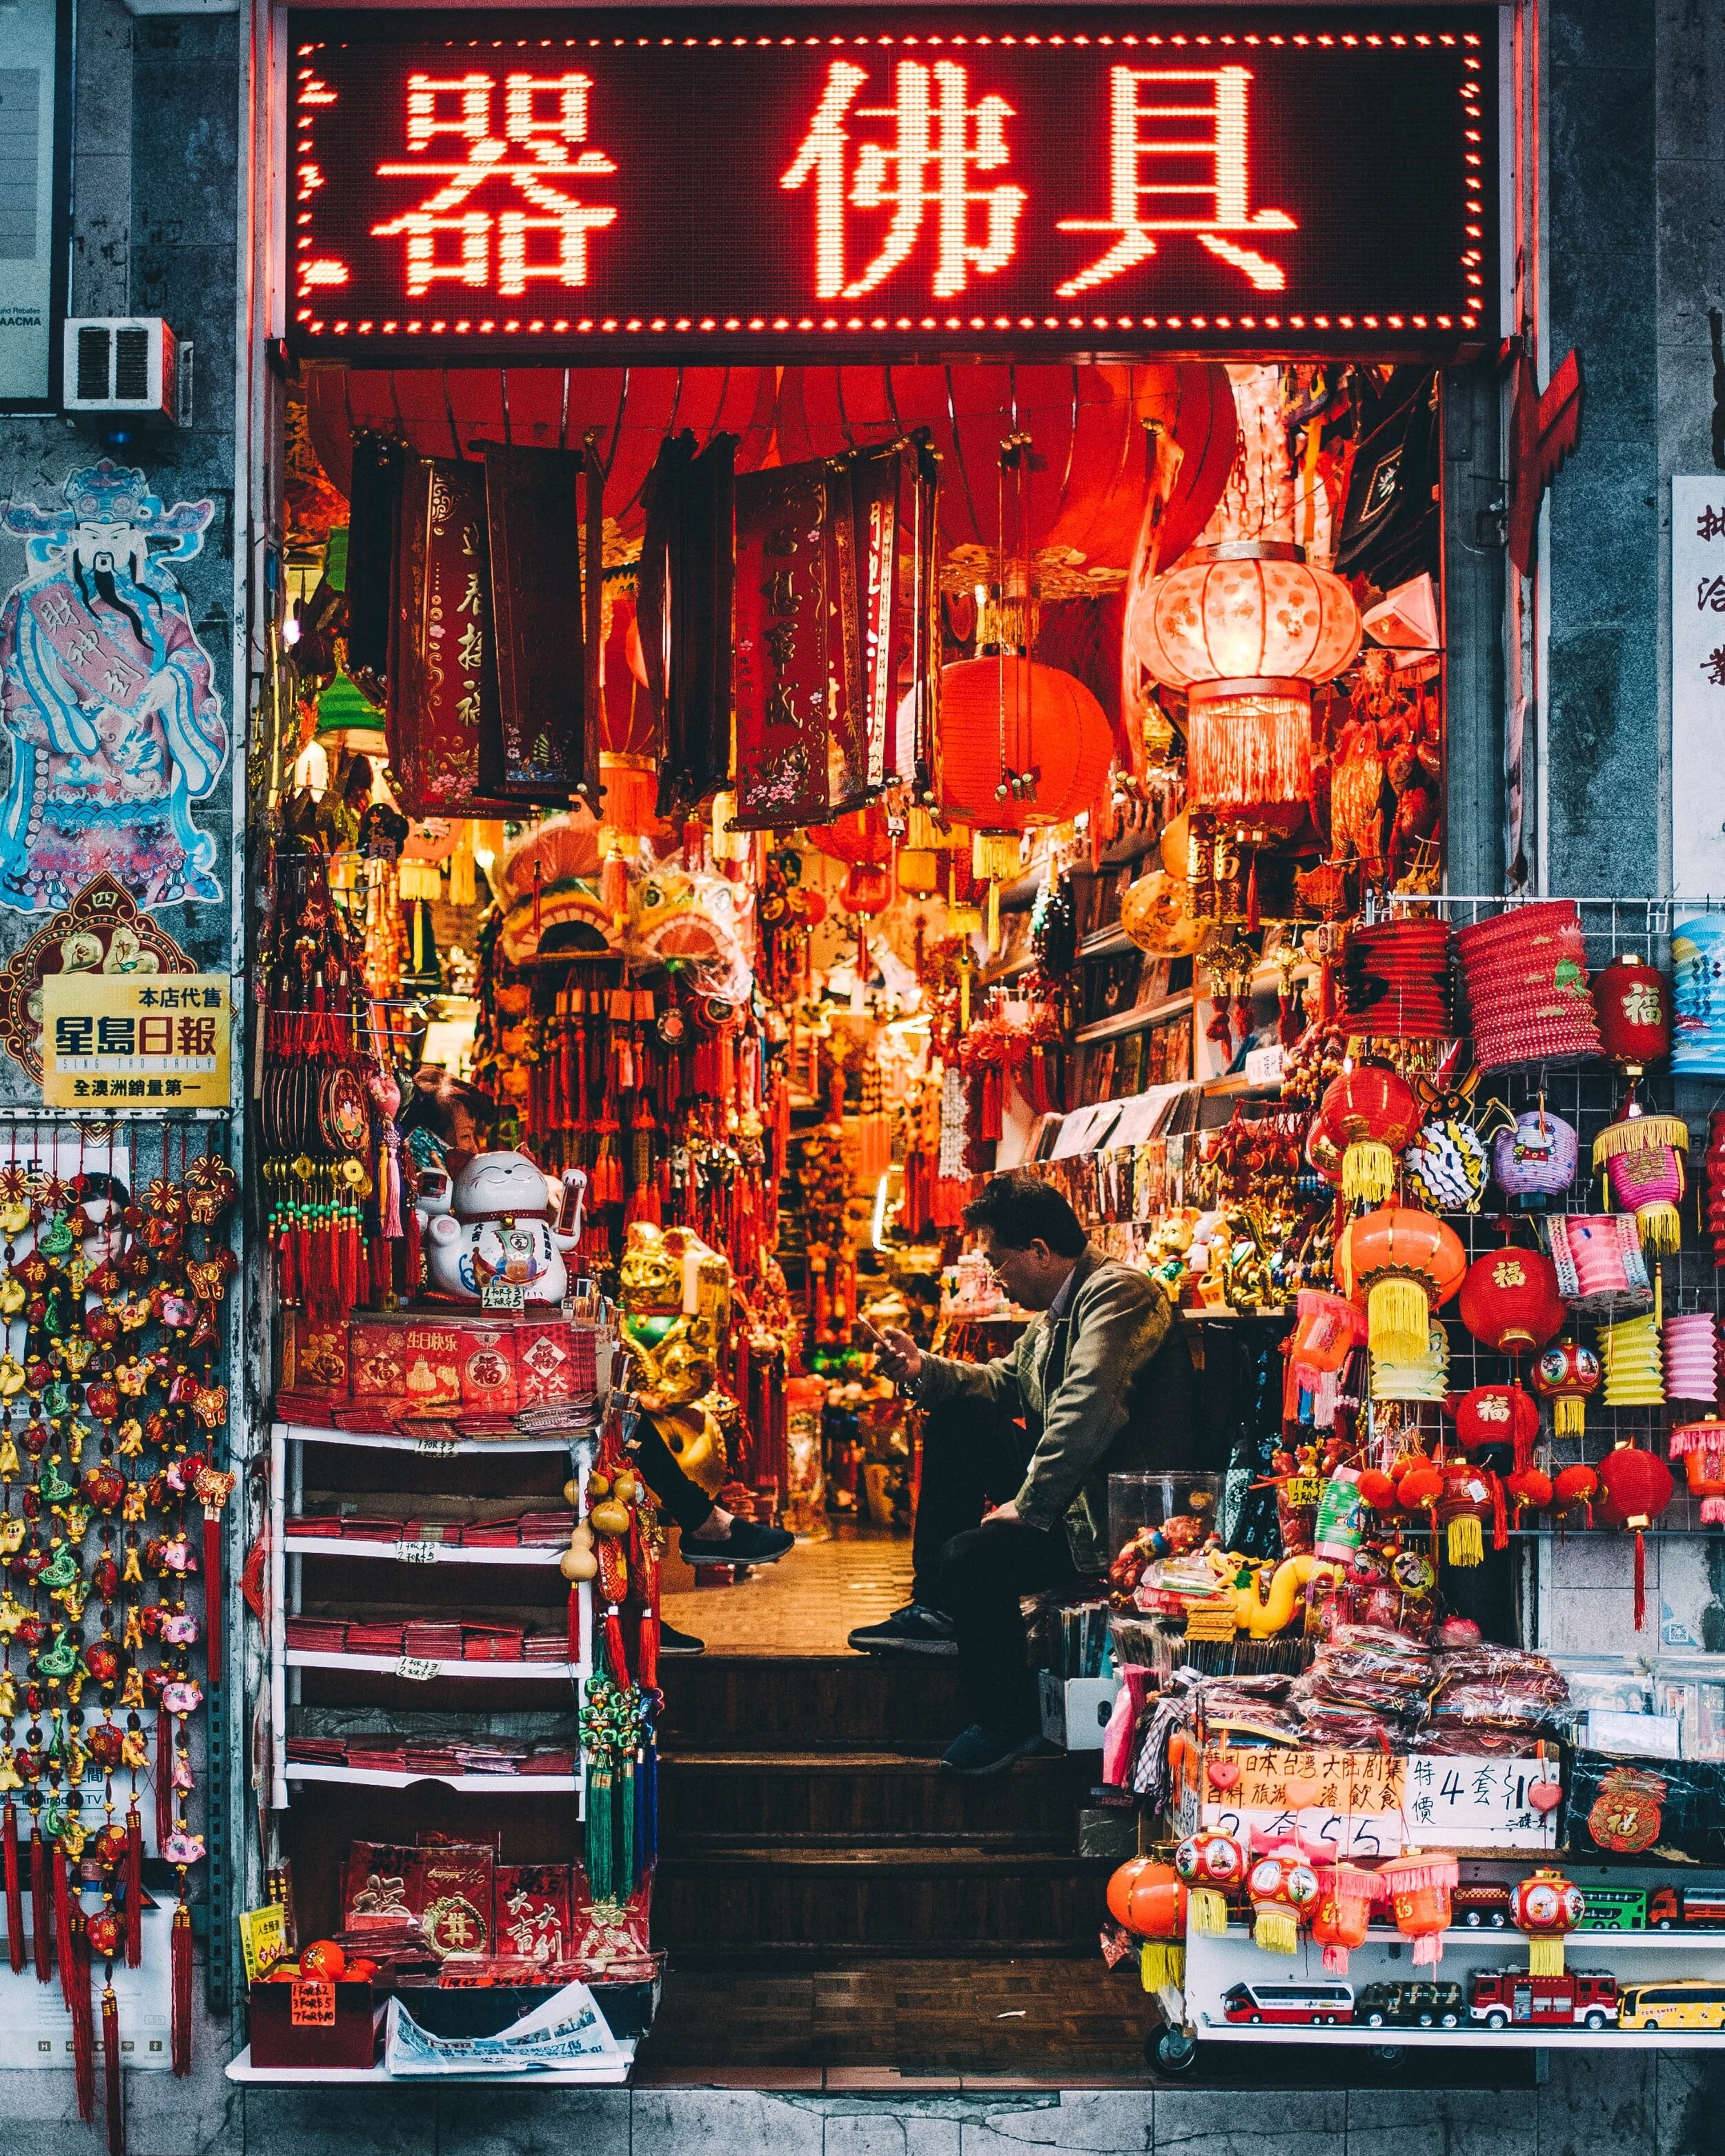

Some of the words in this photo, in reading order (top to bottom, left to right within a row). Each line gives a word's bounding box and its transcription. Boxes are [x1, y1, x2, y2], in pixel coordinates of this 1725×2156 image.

[39, 591, 145, 698] 財神到
[138, 987, 222, 1008] 本店代售
[1621, 982, 1663, 1027] 福
[55, 1016, 216, 1056] 星島日報
[63, 1058, 99, 1069] SING
[118, 1058, 145, 1069] TAO
[163, 1058, 216, 1069] DAILY
[73, 1079, 201, 1097] 全澳洲銷量第一
[67, 1218, 85, 1236] 福
[25, 1260, 47, 1281] 福
[132, 1255, 149, 1275] 福
[1492, 1260, 1526, 1289] 福
[99, 1271, 120, 1291] 福
[485, 1287, 490, 1296] 1
[484, 1297, 493, 1307] 2
[407, 1330, 459, 1352] 生日快乐
[532, 1343, 558, 1369] 福
[369, 1356, 394, 1381] 福
[473, 1355, 502, 1385] 福
[1476, 1394, 1511, 1423] 福
[398, 1666, 406, 1677] 2
[86, 1795, 102, 1805] TV
[293, 1986, 297, 1996] 1
[294, 1999, 299, 2009] 3
[293, 2012, 300, 2021] 7
